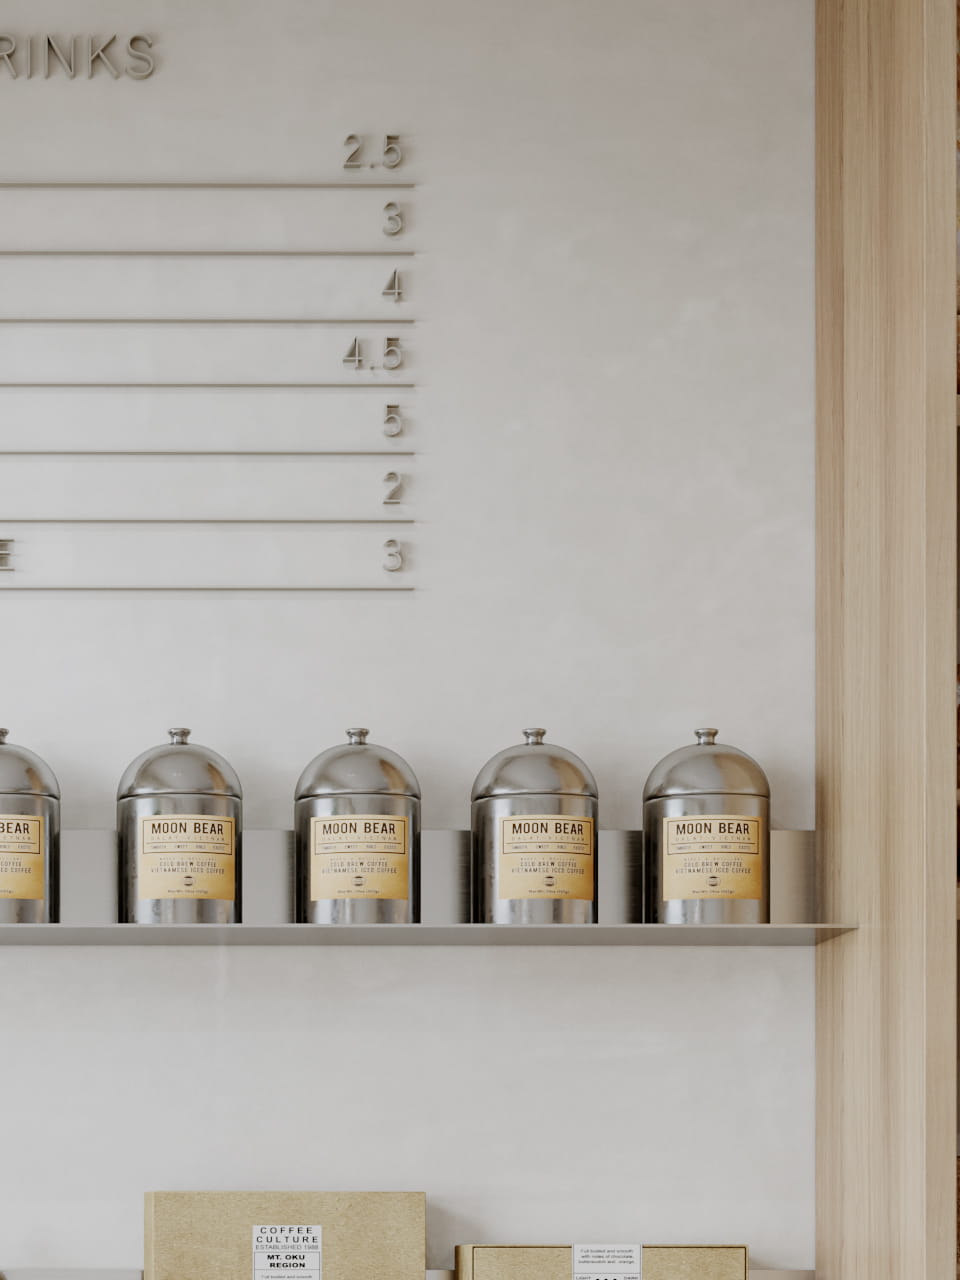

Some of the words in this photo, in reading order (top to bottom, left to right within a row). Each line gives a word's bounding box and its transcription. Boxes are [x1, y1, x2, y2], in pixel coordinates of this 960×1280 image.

[343, 133, 404, 169] 2.5
[382, 202, 404, 237] 3
[381, 268, 404, 303] 4
[342, 337, 404, 372] 4.5
[382, 404, 404, 438] 5
[382, 471, 403, 506] 2
[382, 538, 404, 574] 3
[151, 822, 187, 835] MOON
[193, 822, 224, 835] BEAR
[322, 822, 357, 835] MOON
[364, 822, 396, 835] BEAR
[512, 822, 548, 835] MOON
[554, 822, 583, 835] BEAR
[676, 822, 712, 835] MOON
[718, 822, 750, 835] BEAR
